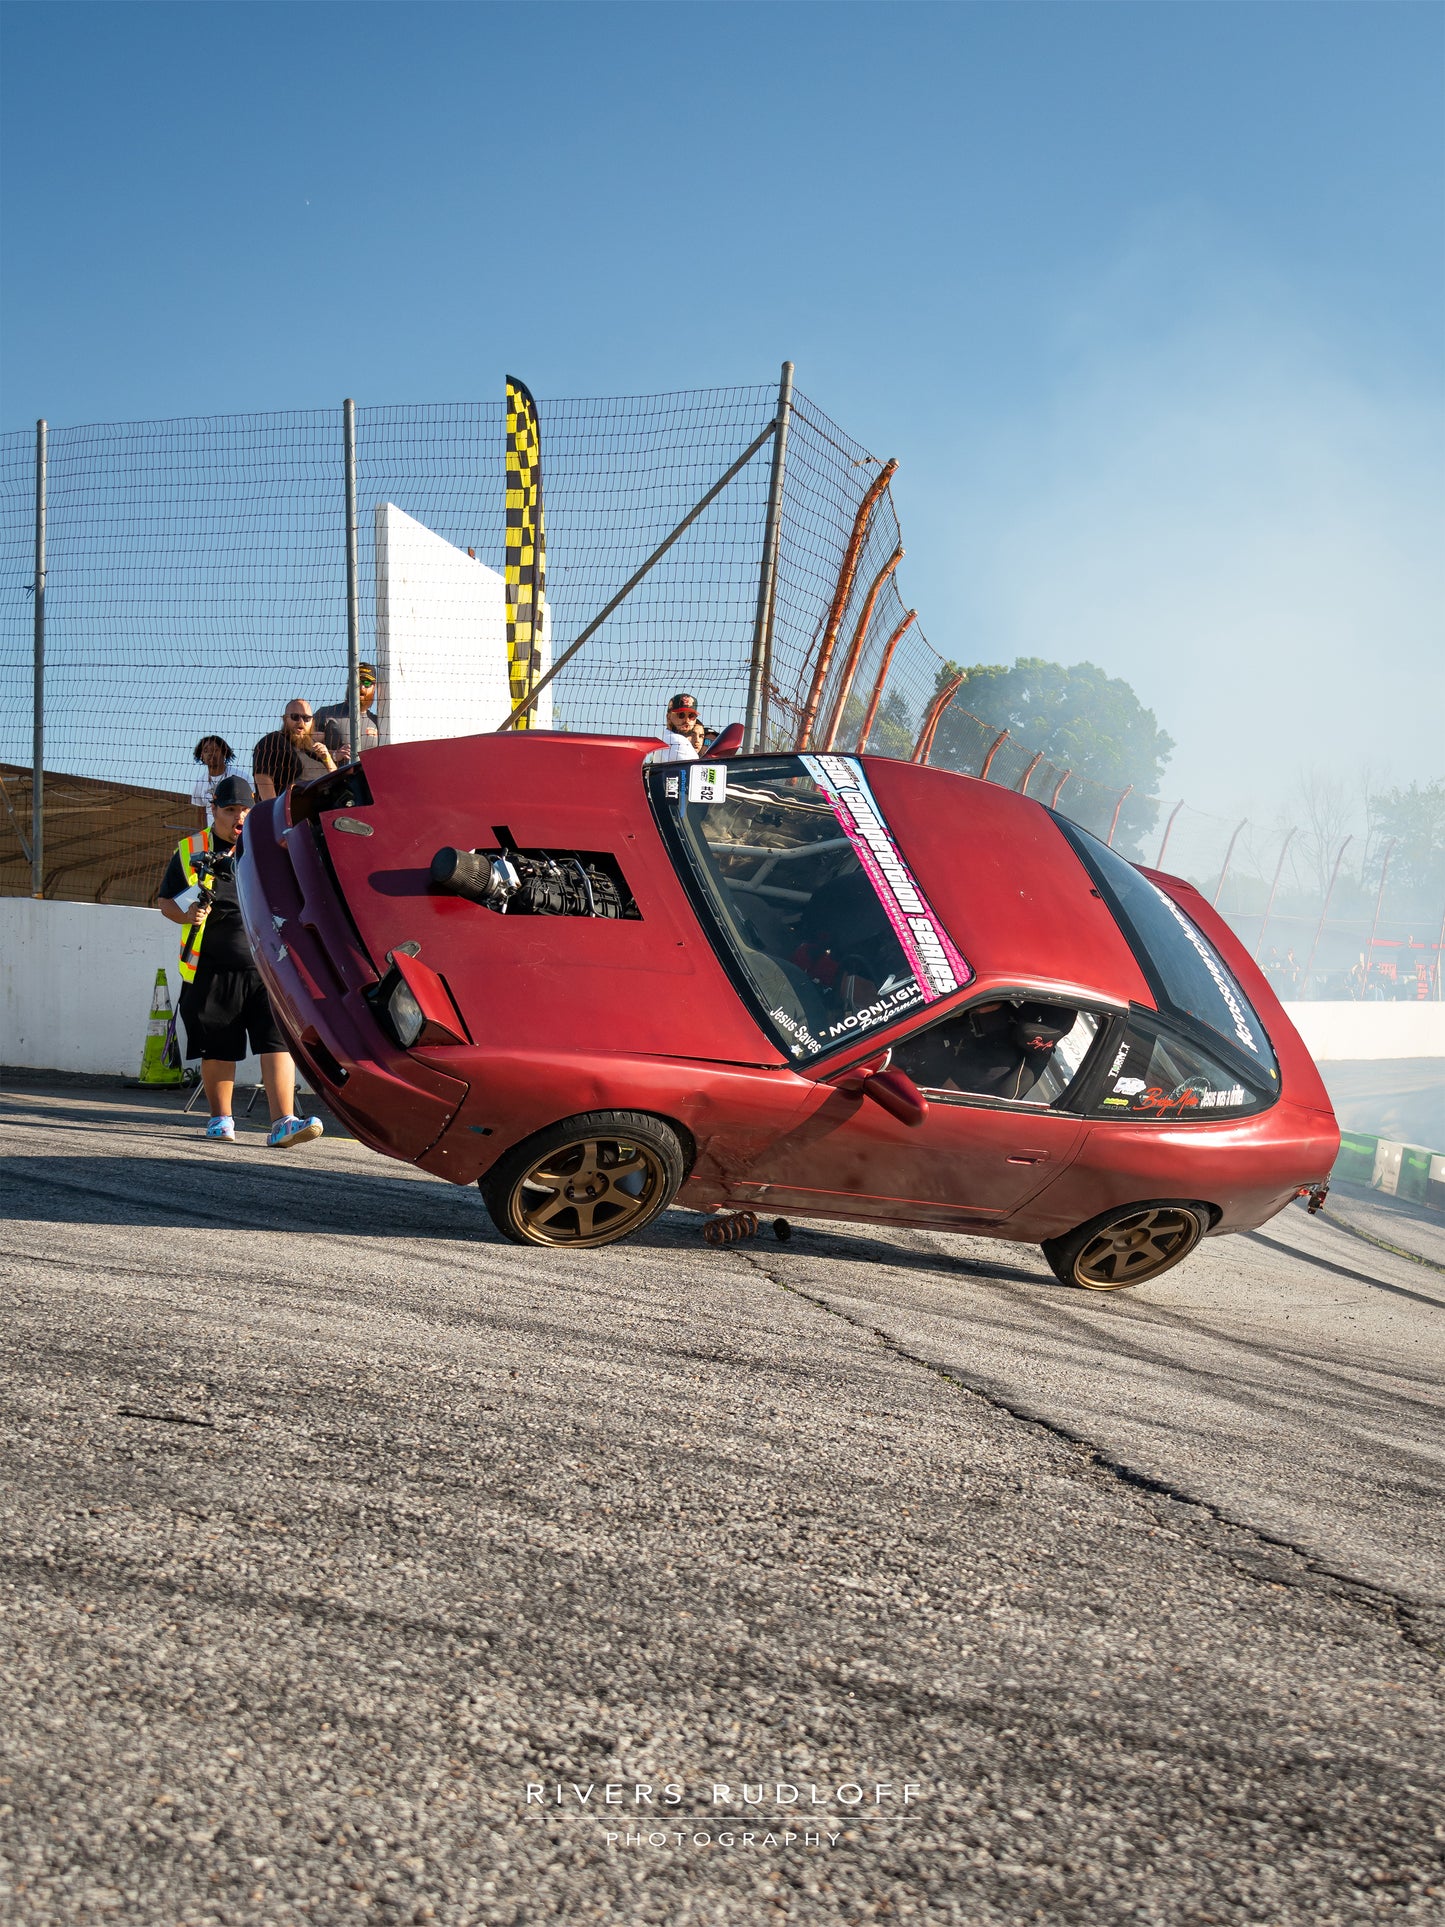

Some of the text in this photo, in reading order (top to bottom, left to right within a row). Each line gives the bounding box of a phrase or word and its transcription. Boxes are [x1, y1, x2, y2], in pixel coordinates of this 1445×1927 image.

[700, 786, 714, 800] #32
[770, 1006, 822, 1054] Jesus Saves
[829, 983, 921, 1037] MOONLIGH
[859, 995, 925, 1031] Performan
